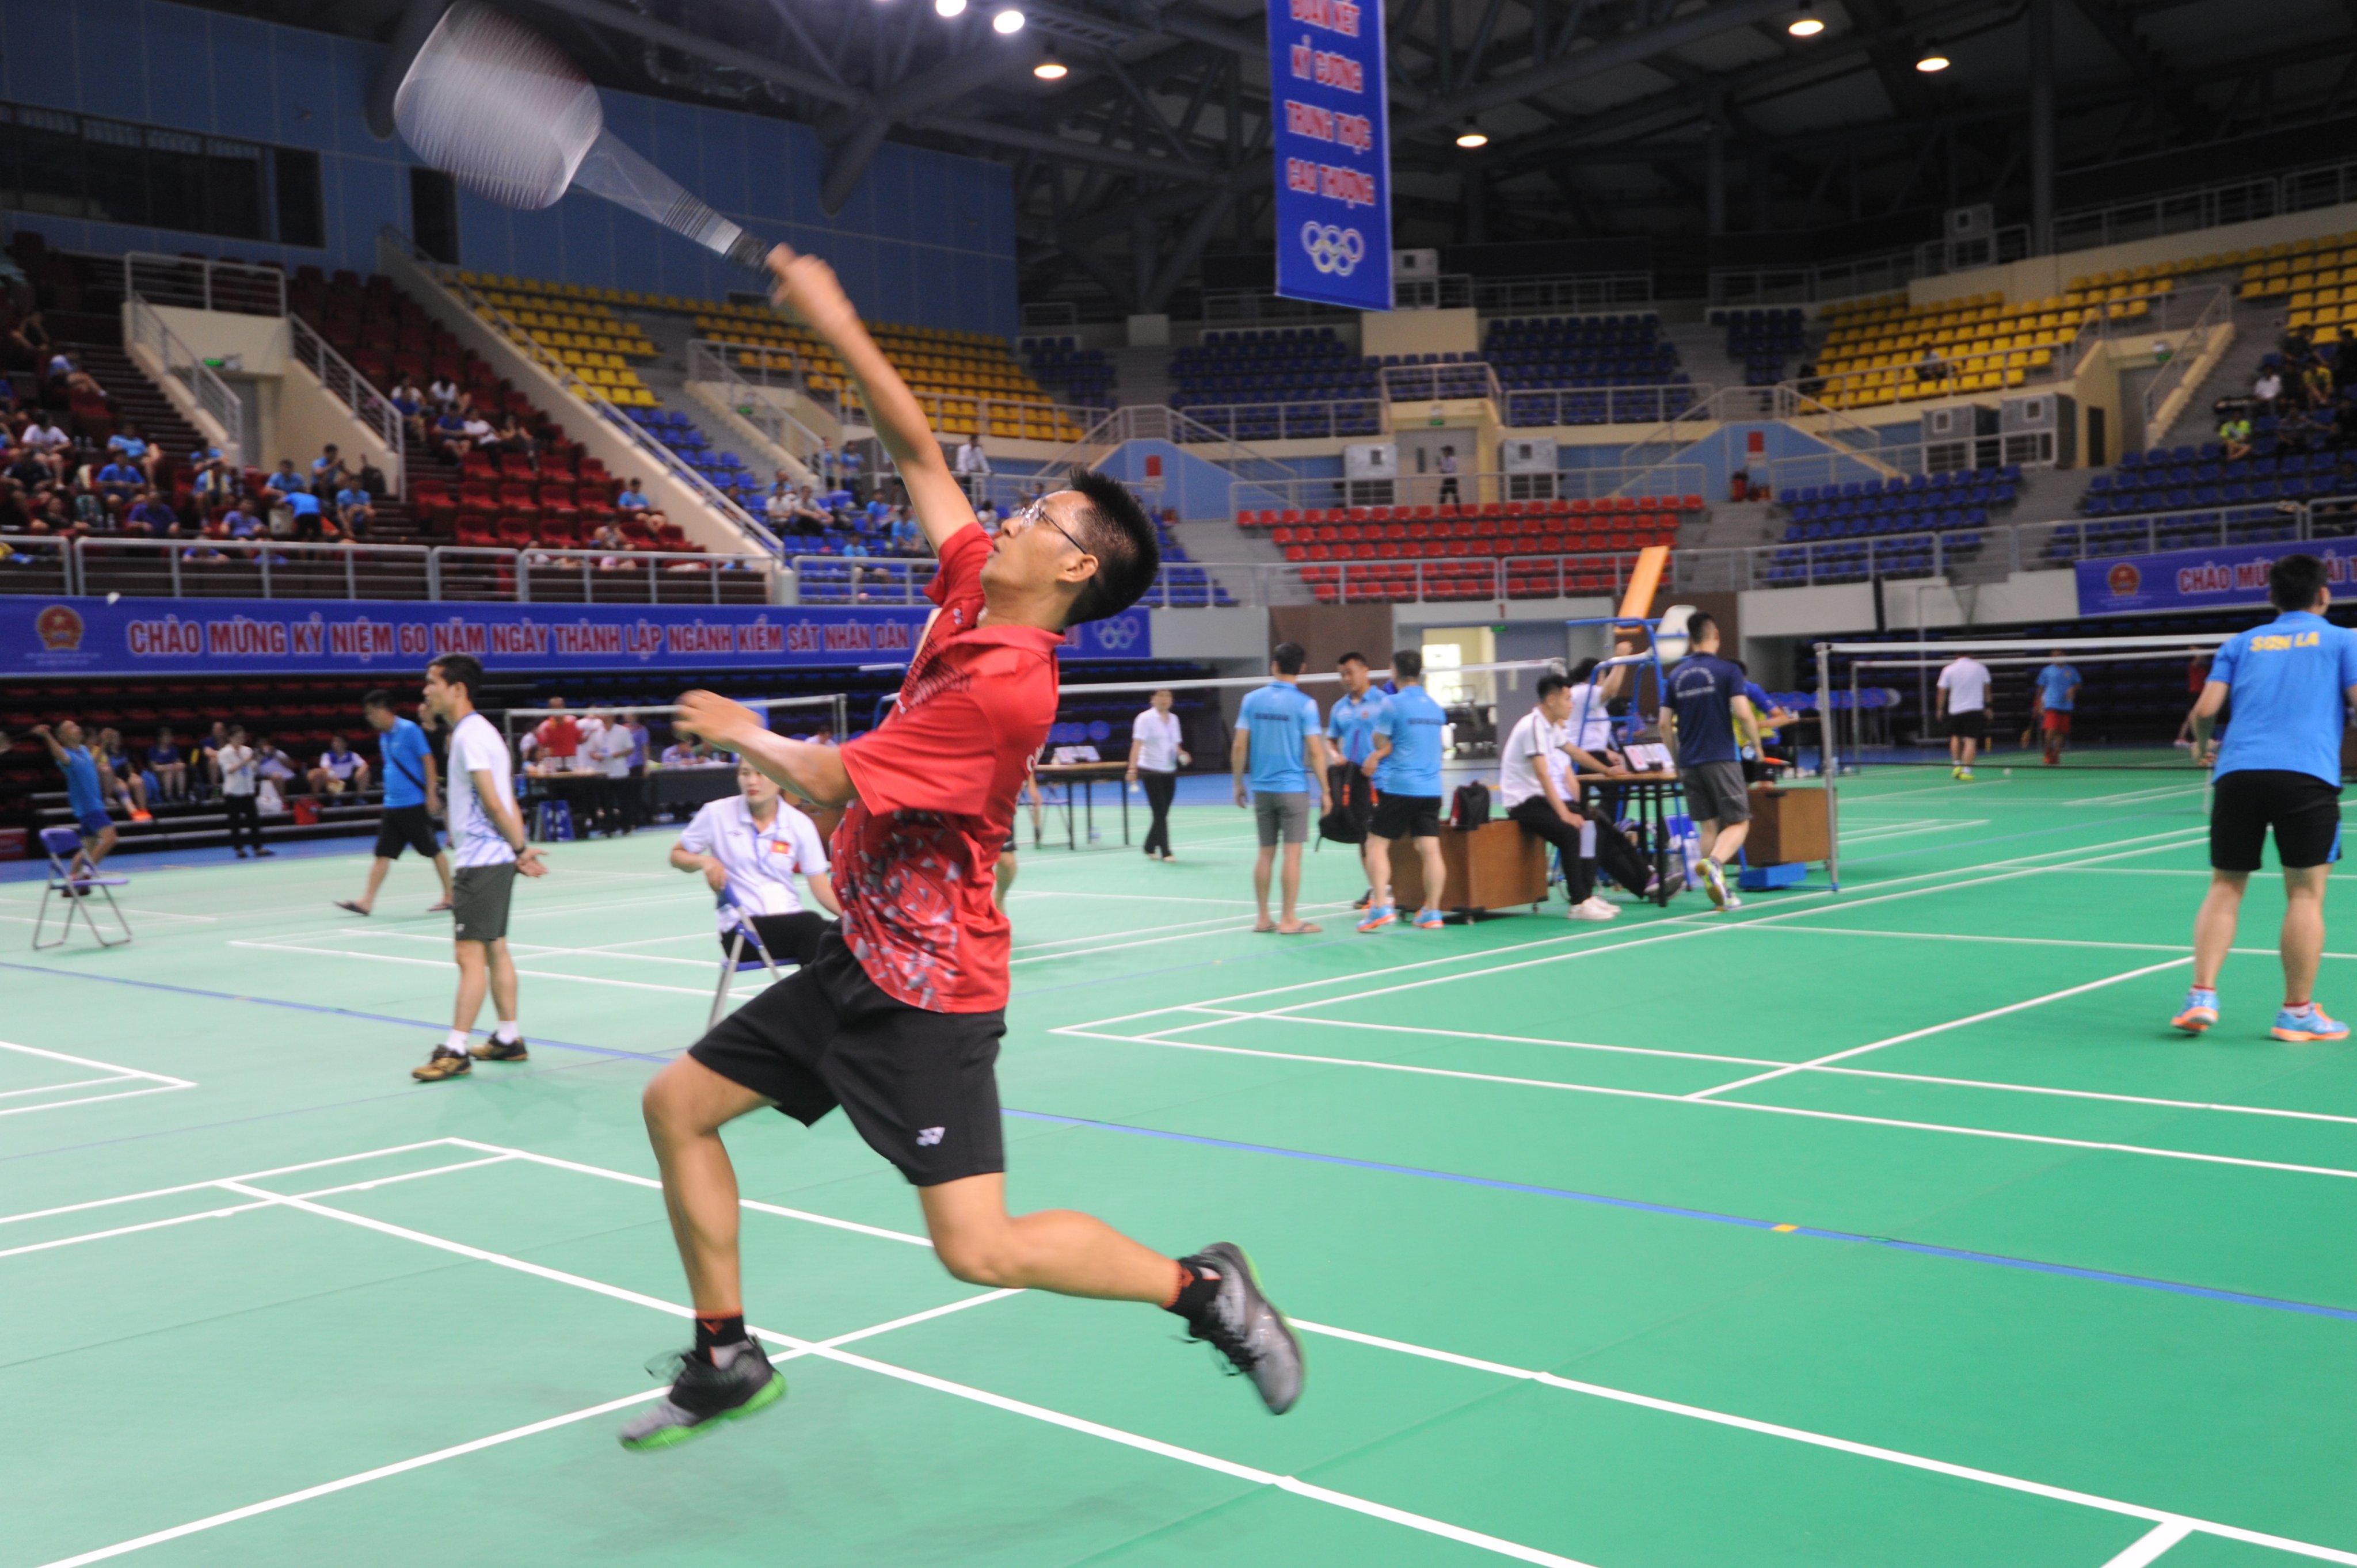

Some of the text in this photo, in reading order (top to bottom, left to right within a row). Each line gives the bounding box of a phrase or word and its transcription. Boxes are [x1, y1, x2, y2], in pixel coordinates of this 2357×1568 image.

[127, 614, 201, 655] CHÀO
[207, 615, 288, 655] MỪNG
[291, 612, 323, 655] KỶ
[329, 616, 394, 661] NIỆM
[398, 623, 428, 655] 60
[432, 617, 487, 654] NĂM
[491, 618, 548, 654] NGÀY
[553, 619, 622, 654] THÀNH
[626, 619, 662, 660] LẬP
[666, 619, 733, 653] NGÀNH
[737, 614, 783, 652] KIỂM
[787, 619, 820, 651] SÁT
[824, 619, 871, 651] NHÂN
[874, 619, 909, 650] DÂN
[2294, 631, 2319, 647] LA
